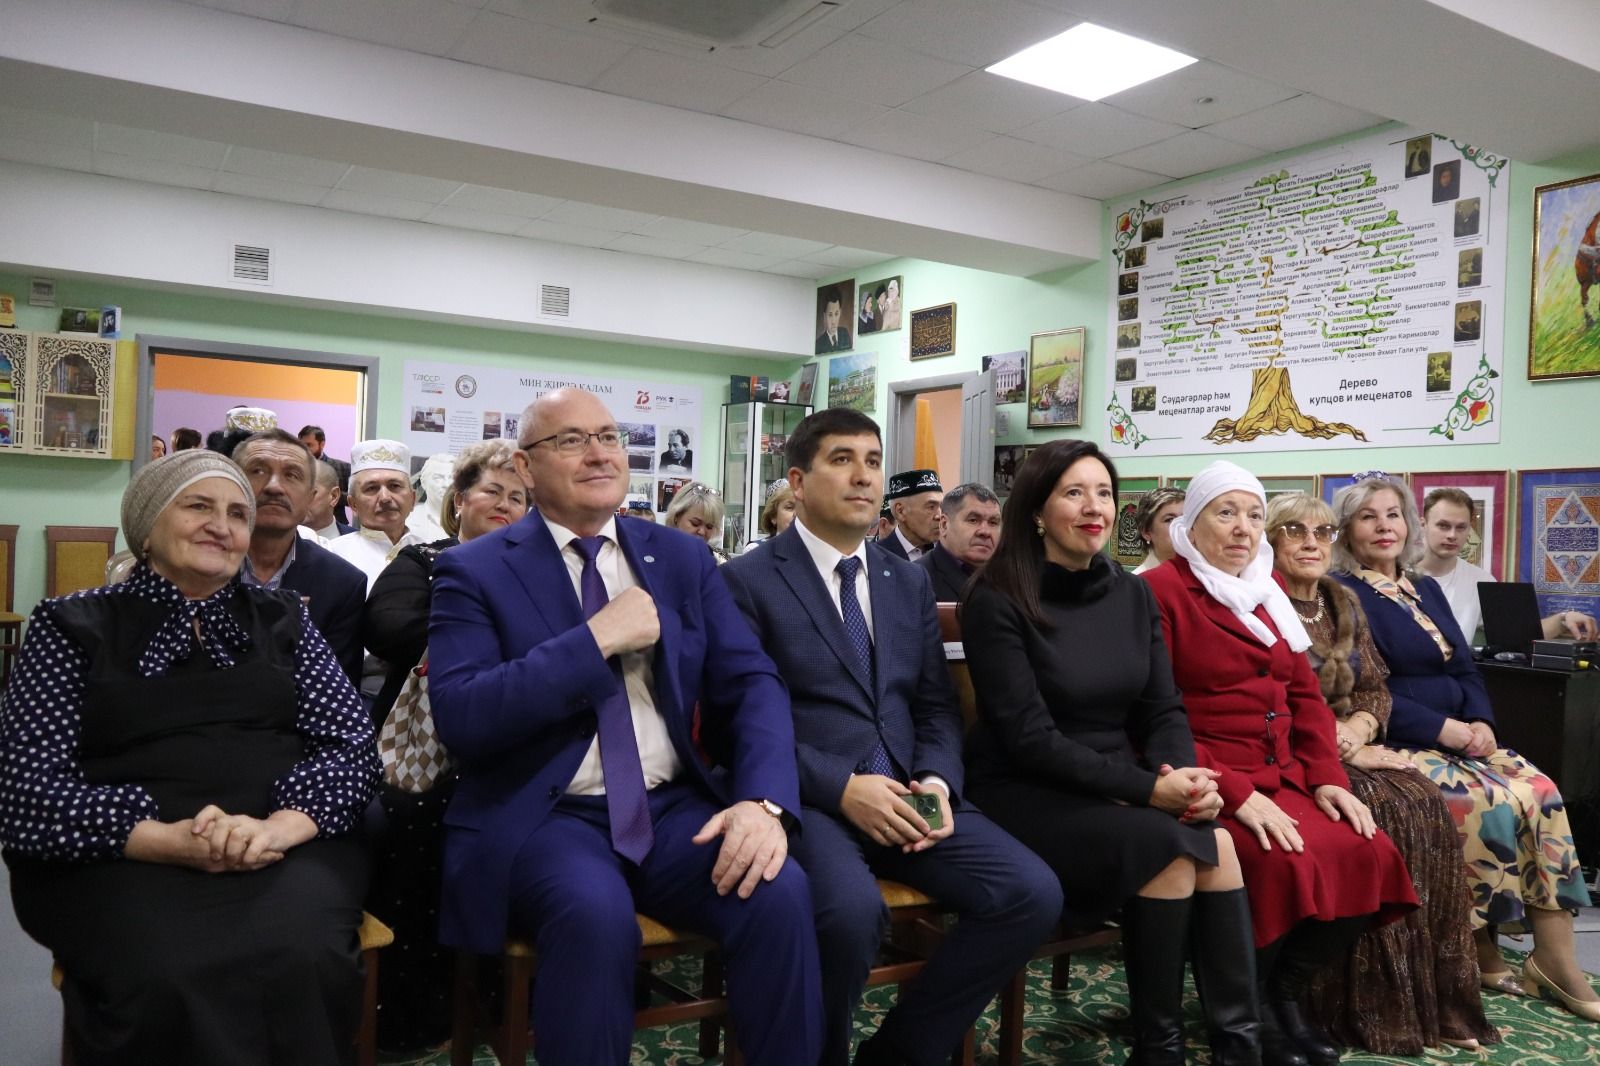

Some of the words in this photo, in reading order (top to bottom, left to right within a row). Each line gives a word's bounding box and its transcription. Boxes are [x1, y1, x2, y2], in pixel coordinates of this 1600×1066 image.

[1321, 222, 1339, 232] Идрис
[520, 378, 542, 388] МИН
[1339, 378, 1378, 390] Дерево
[1214, 391, 1231, 402] һәм
[1310, 394, 1345, 406] купцов
[1354, 389, 1413, 402] меценатов
[1158, 406, 1205, 417] меценатлар
[1206, 404, 1231, 414] агачы
